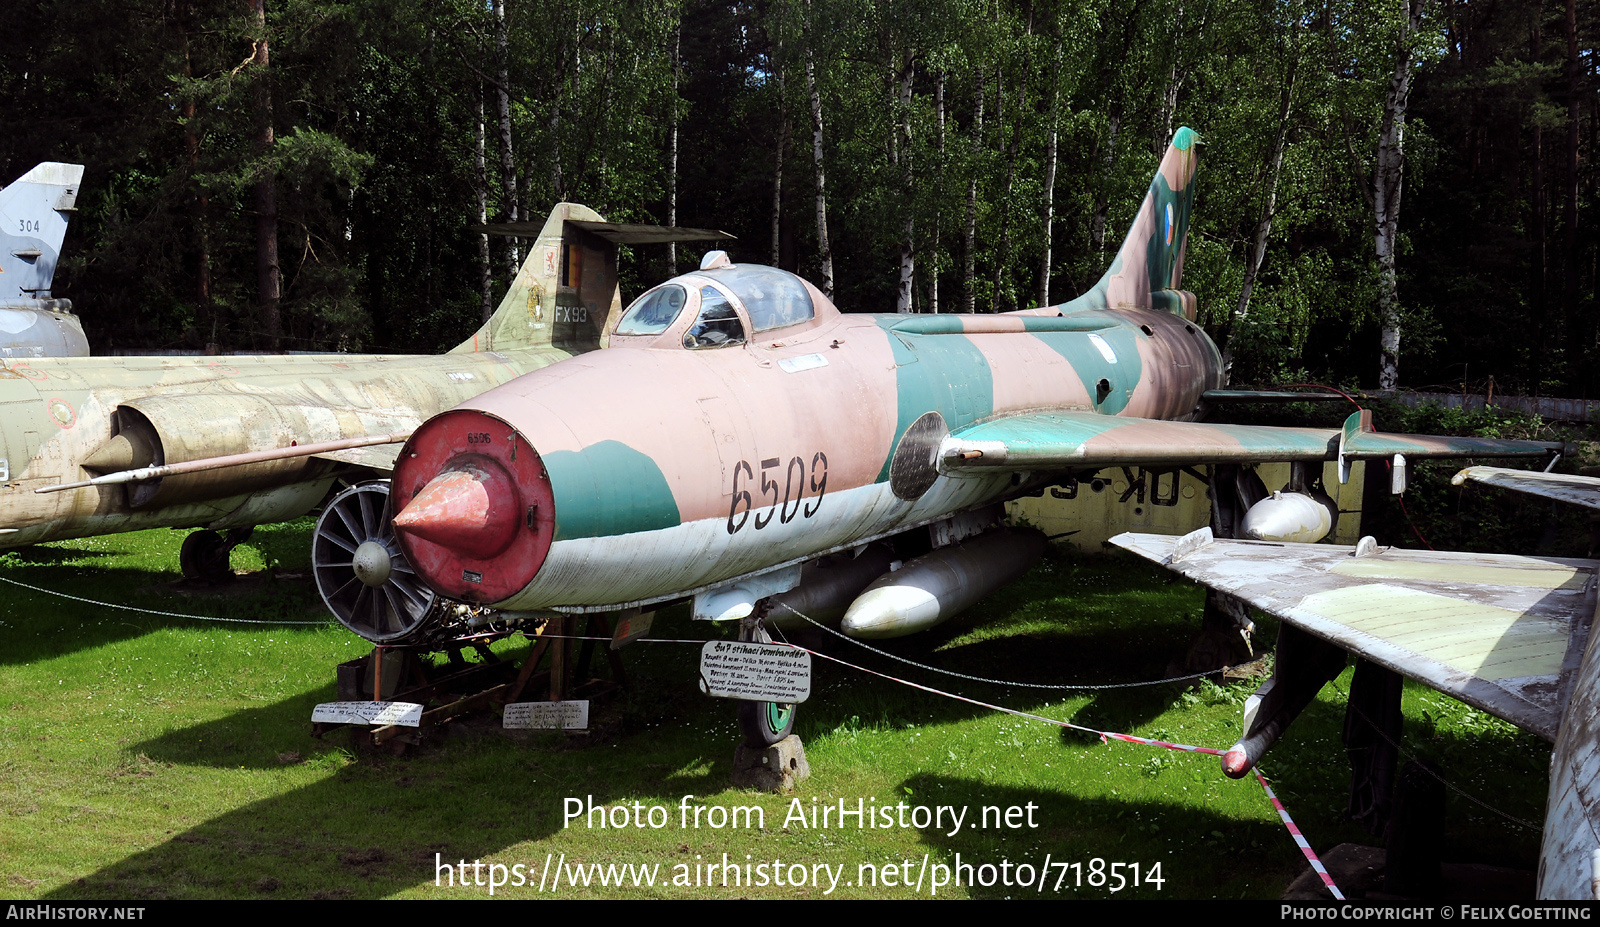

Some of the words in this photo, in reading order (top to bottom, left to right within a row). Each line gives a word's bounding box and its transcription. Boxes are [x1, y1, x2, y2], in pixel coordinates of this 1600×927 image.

[19, 219, 40, 232] 304
[556, 306, 587, 323] FX93
[726, 451, 828, 535] 6509
